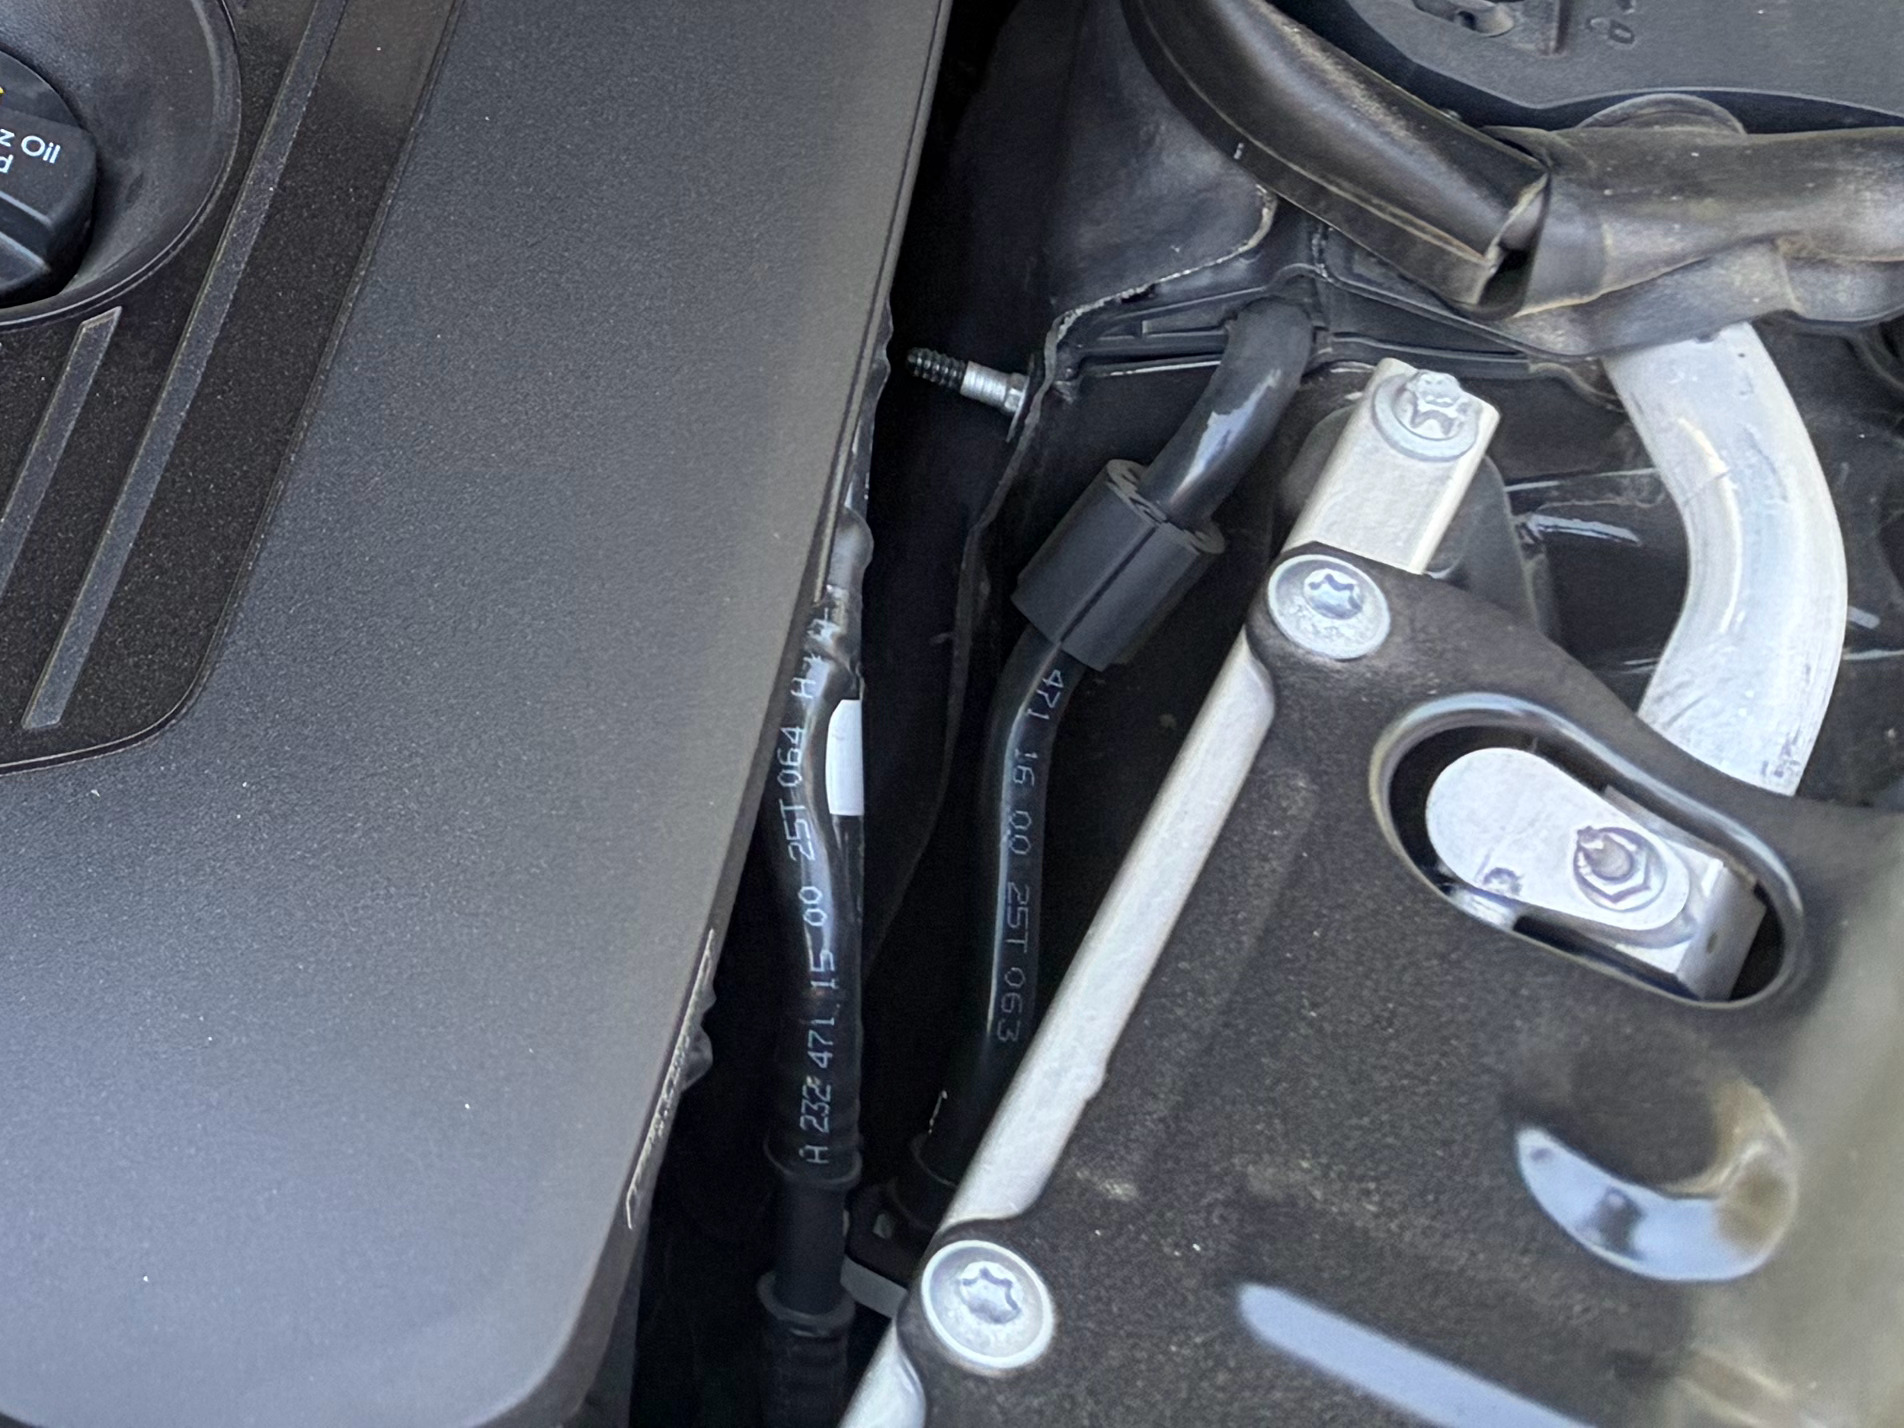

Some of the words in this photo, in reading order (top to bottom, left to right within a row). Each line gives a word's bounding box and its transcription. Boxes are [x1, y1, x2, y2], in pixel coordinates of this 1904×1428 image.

[21, 134, 62, 165] Oil
[1027, 669, 1064, 720] 471
[777, 726, 805, 788] 064
[1013, 748, 1038, 787] 16
[779, 799, 816, 861] 25T
[1009, 810, 1033, 855] 00
[1005, 881, 1030, 954] 25T
[996, 967, 1026, 1042] 063
[807, 1017, 834, 1069] 471
[800, 1084, 831, 1134] 232
